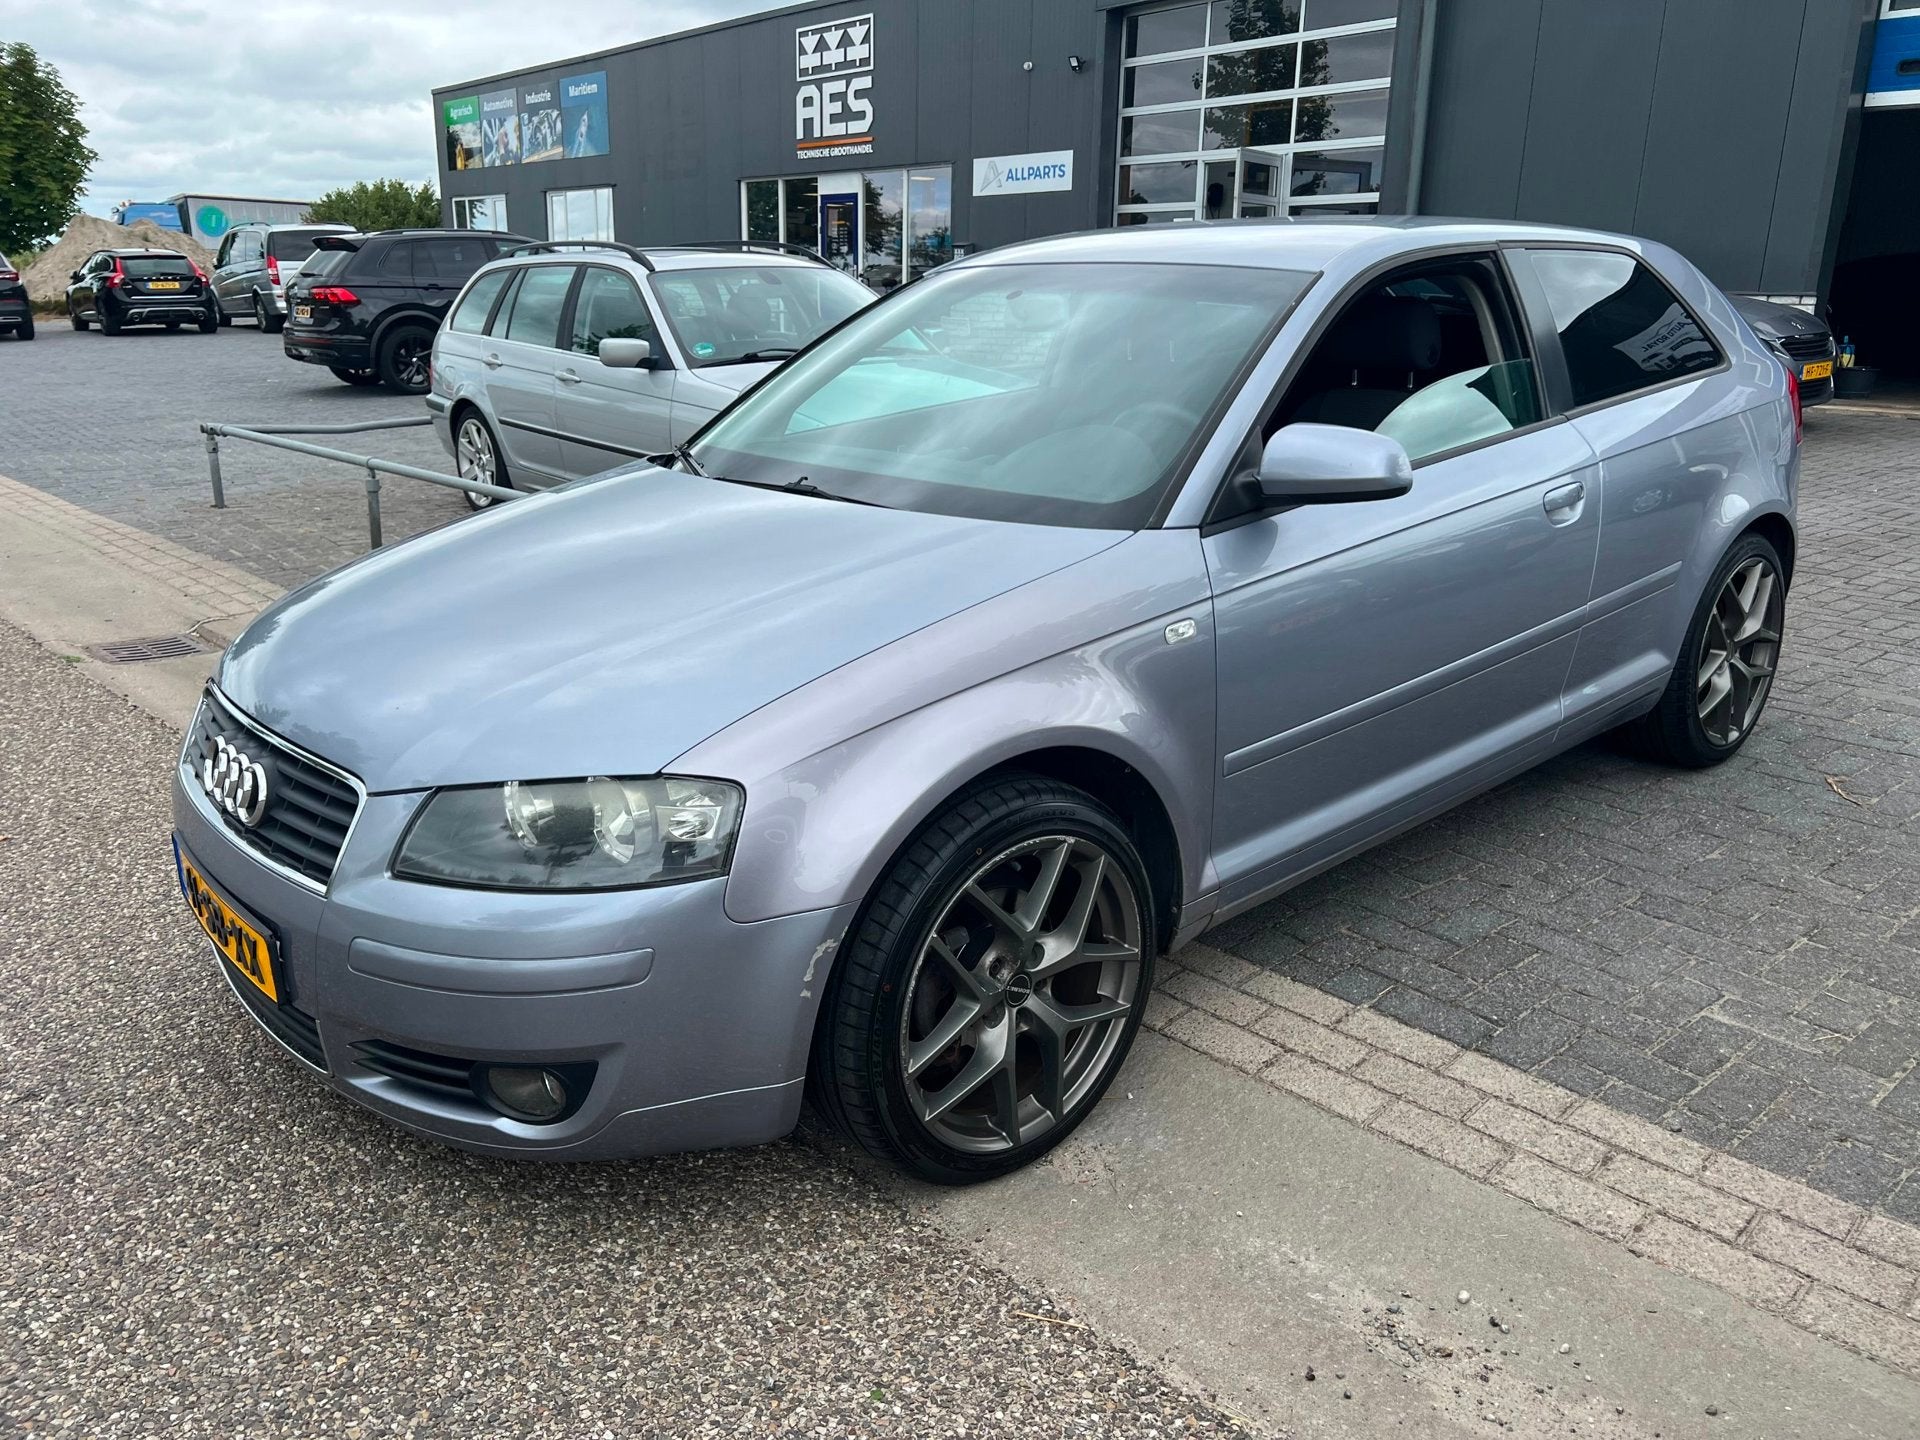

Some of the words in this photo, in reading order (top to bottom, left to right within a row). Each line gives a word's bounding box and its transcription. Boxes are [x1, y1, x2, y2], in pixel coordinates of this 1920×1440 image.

[525, 90, 552, 105] Industrie
[568, 83, 598, 98] Maritiem
[450, 104, 473, 120] Agrarisch
[483, 97, 514, 112] Automotive
[796, 75, 874, 140] AES
[796, 147, 830, 160] TECHNISCHE
[829, 143, 874, 157] GROOTHANDEL
[1005, 163, 1067, 182] ALLPARTS
